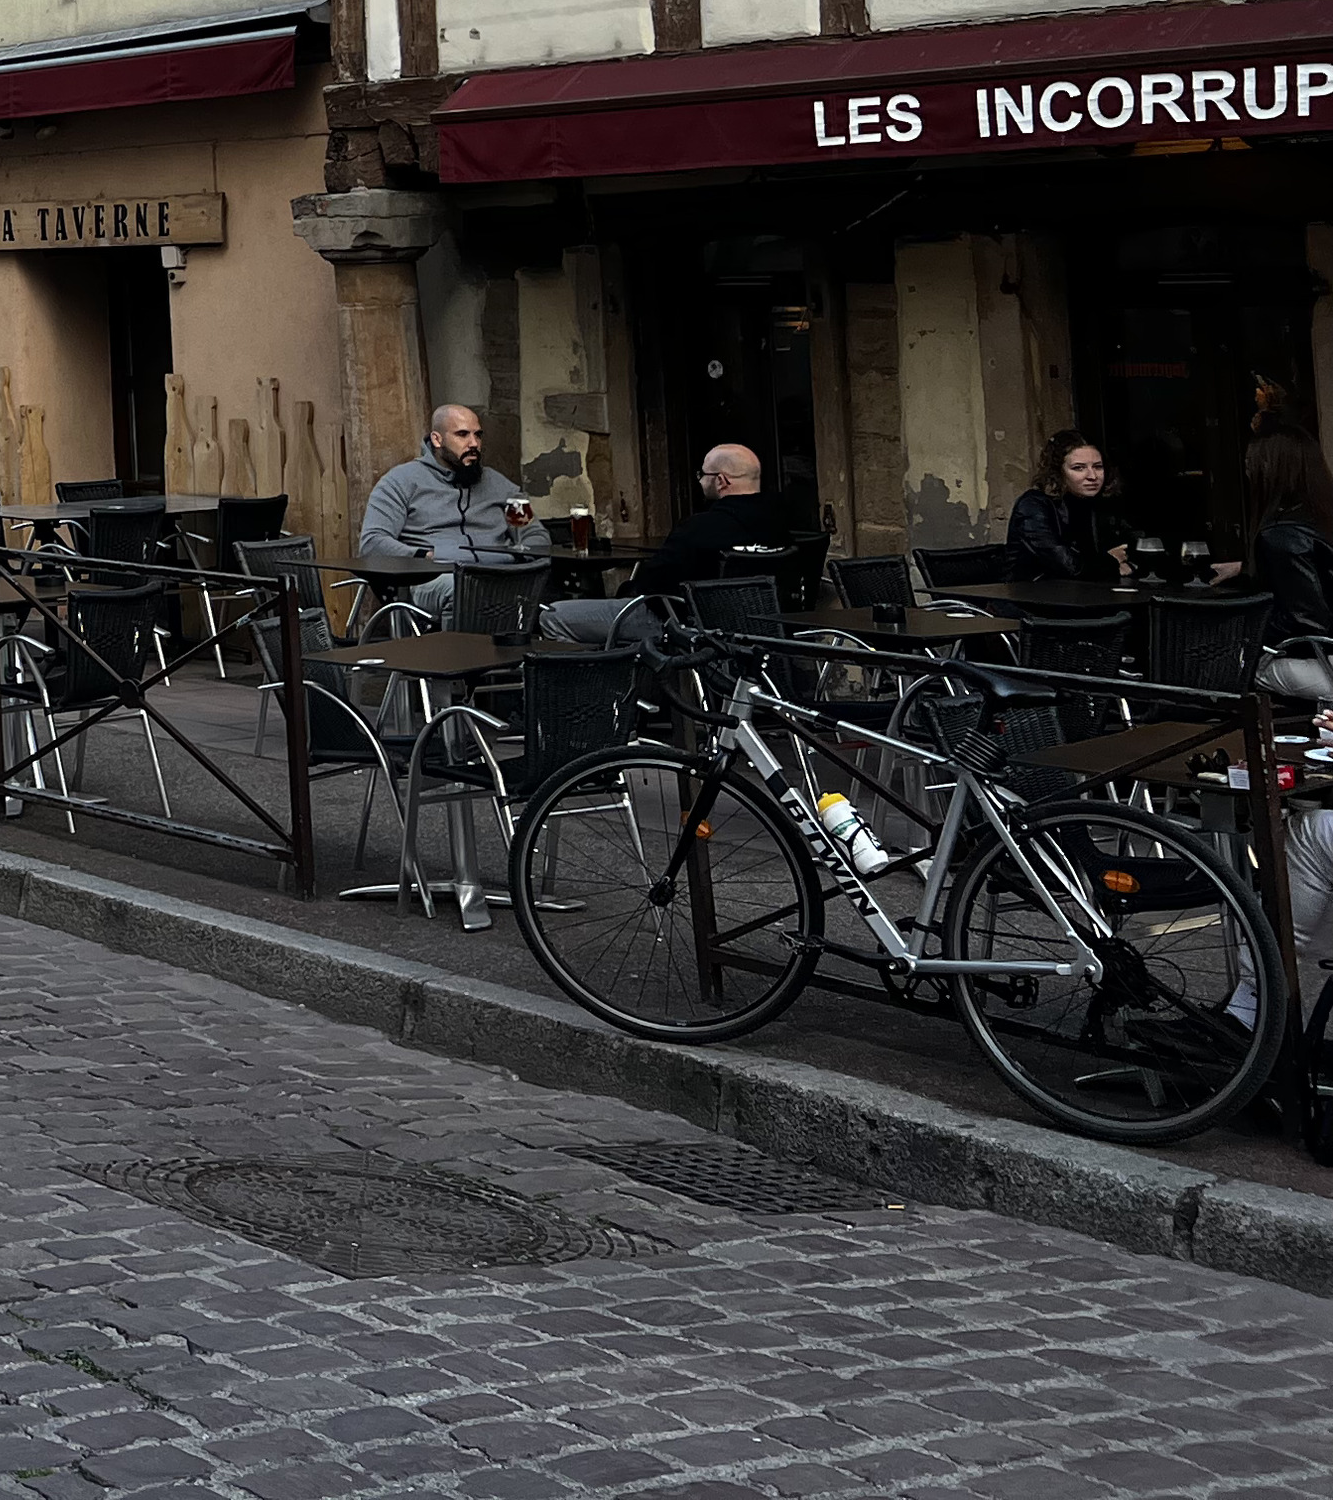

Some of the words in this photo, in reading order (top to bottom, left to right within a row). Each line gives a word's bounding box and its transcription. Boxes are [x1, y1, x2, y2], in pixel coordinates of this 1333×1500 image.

[812, 93, 923, 147] LES
[976, 62, 1333, 139] INCORRUP
[37, 201, 170, 242] TAVERNE
